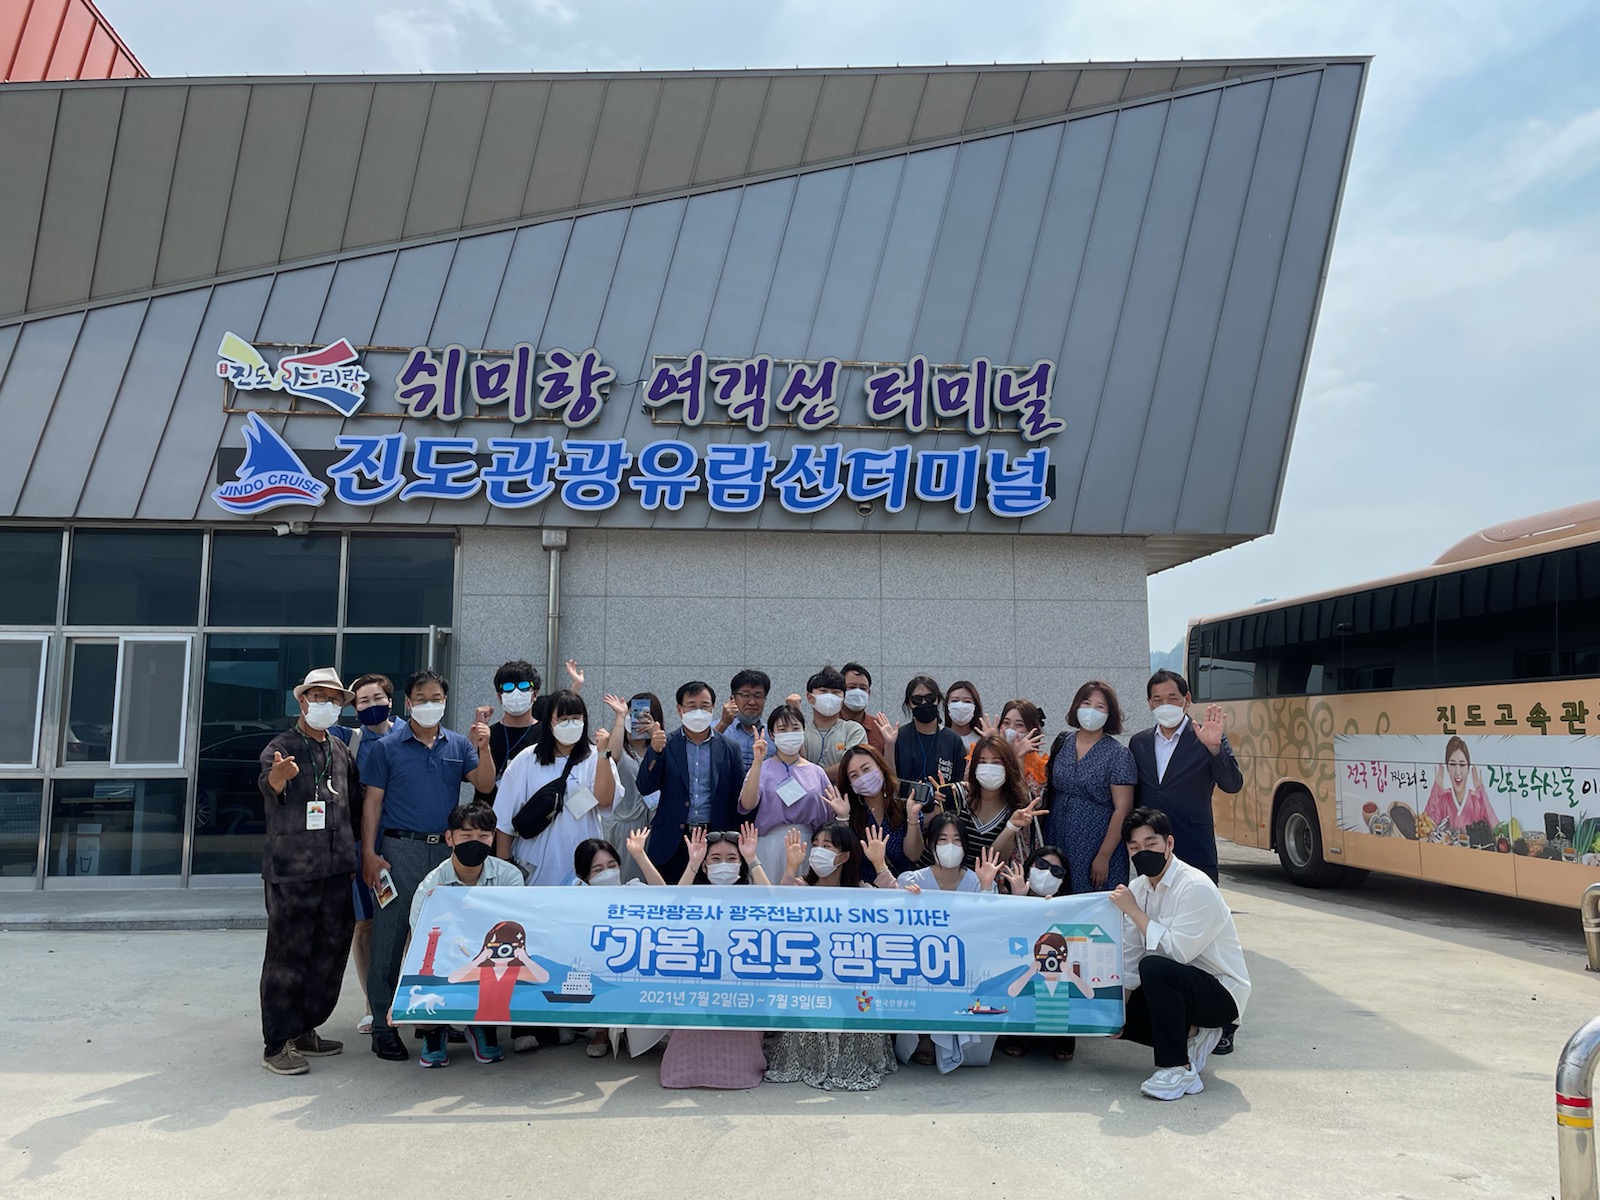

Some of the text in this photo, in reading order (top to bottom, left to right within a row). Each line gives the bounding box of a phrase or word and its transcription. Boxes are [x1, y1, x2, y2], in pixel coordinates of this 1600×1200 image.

[398, 345, 1064, 436] 쉬미항 여객선 터미널
[220, 474, 322, 496] JINDO CRUISE
[328, 433, 1051, 515] 진도관광유람선터미널
[1437, 700, 1600, 735] 진도고속관
[1347, 762, 1368, 789] 전국
[1487, 765, 1579, 808] 진도농수산물
[607, 904, 951, 927] 한국관광공사 광주전남지사 SNS 기자단
[728, 929, 824, 981] 진도
[829, 932, 966, 987] 팸투어
[639, 990, 686, 1006] 2021년
[689, 991, 709, 1008] 7월
[712, 992, 755, 1008] 2일(금)
[768, 994, 788, 1010] 7월
[790, 995, 833, 1011] 3일(토)
